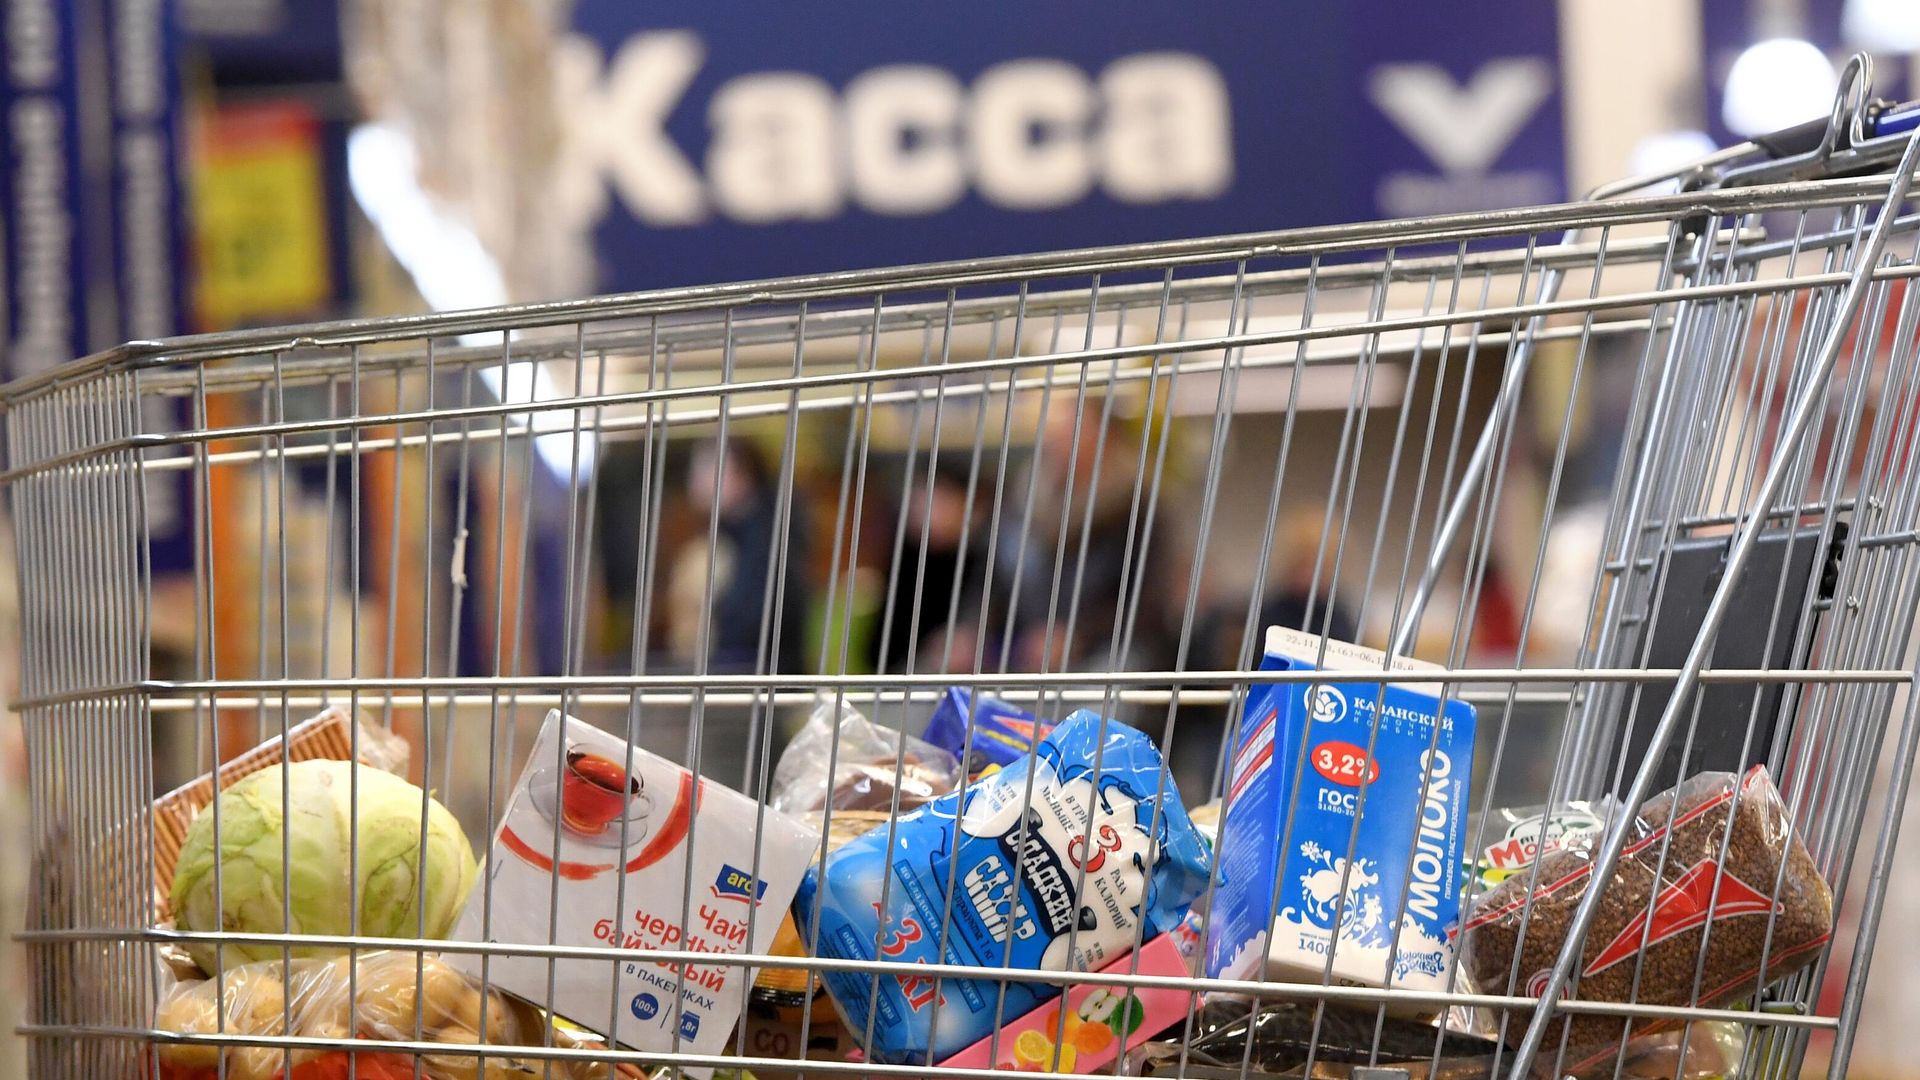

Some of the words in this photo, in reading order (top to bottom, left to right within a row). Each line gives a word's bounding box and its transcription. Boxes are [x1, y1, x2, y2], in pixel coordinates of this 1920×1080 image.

[552, 30, 1231, 226] Касса
[1353, 716, 1452, 747] КОМБИНТ
[1318, 748, 1374, 780] 3,2%
[1318, 787, 1366, 809] ГОС
[1408, 749, 1451, 921] МОЛОКО
[963, 855, 1036, 943] САХАР
[1005, 829, 1074, 935] СЛАДКИЙ
[1110, 867, 1127, 896] РАЗА
[698, 904, 748, 944] Чай
